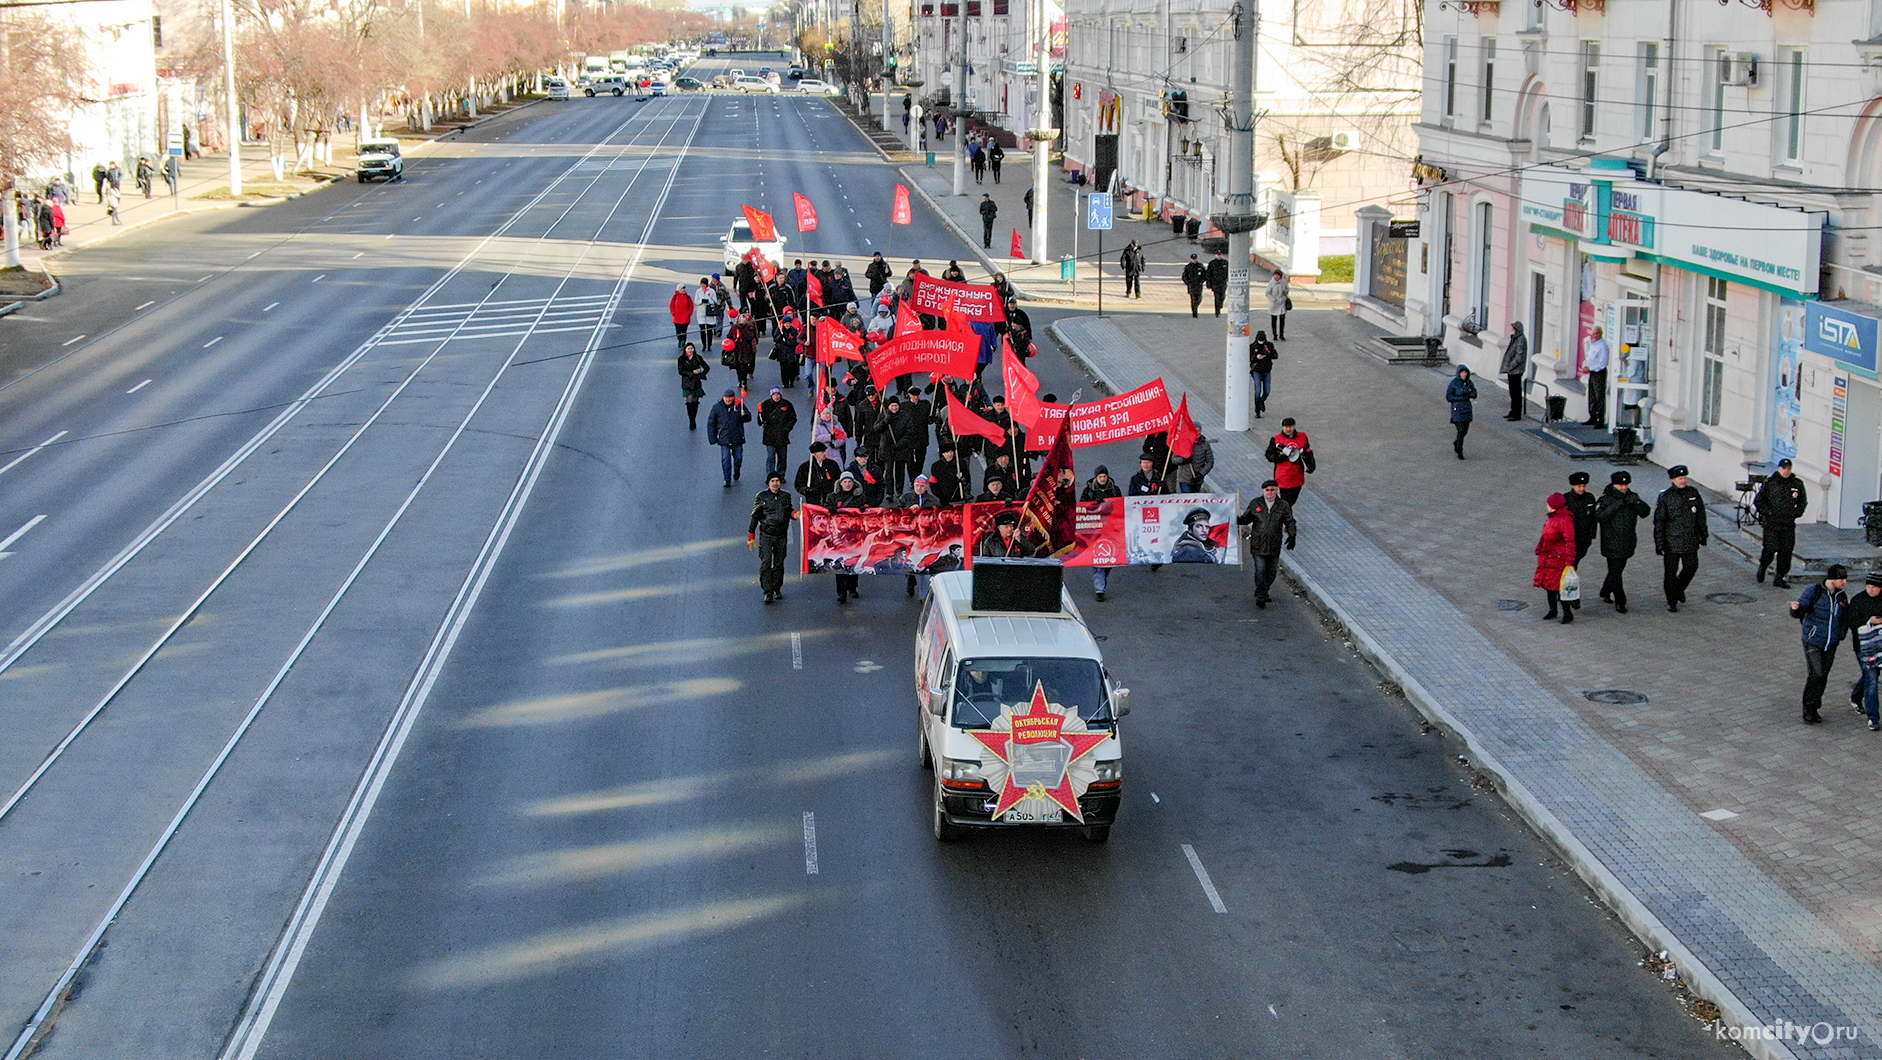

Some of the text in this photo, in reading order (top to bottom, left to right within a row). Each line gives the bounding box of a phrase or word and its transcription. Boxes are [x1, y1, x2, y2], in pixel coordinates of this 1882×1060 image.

[1612, 190, 1637, 211] ПЕРВАЯ
[1608, 212, 1640, 244] АПТЕКА
[1692, 244, 1708, 258] ВАШЕ
[1709, 248, 1739, 266] ЗДОРОВЬЕ
[1740, 256, 1748, 268] НА
[1750, 258, 1776, 274] ПЕРВОМ
[916, 298, 922, 306] В
[900, 339, 965, 353] ПОДНИМАЙСЯ
[914, 352, 952, 364] НАРОД!
[1072, 411, 1130, 431] НОВАЯ ЭРА
[1038, 435, 1045, 446] В
[1142, 526, 1160, 534] 2017
[1014, 718, 1059, 728] ОКТЯБРЬСКАЯ
[1018, 730, 1057, 740] РЕВОЛЮЦИЯ
